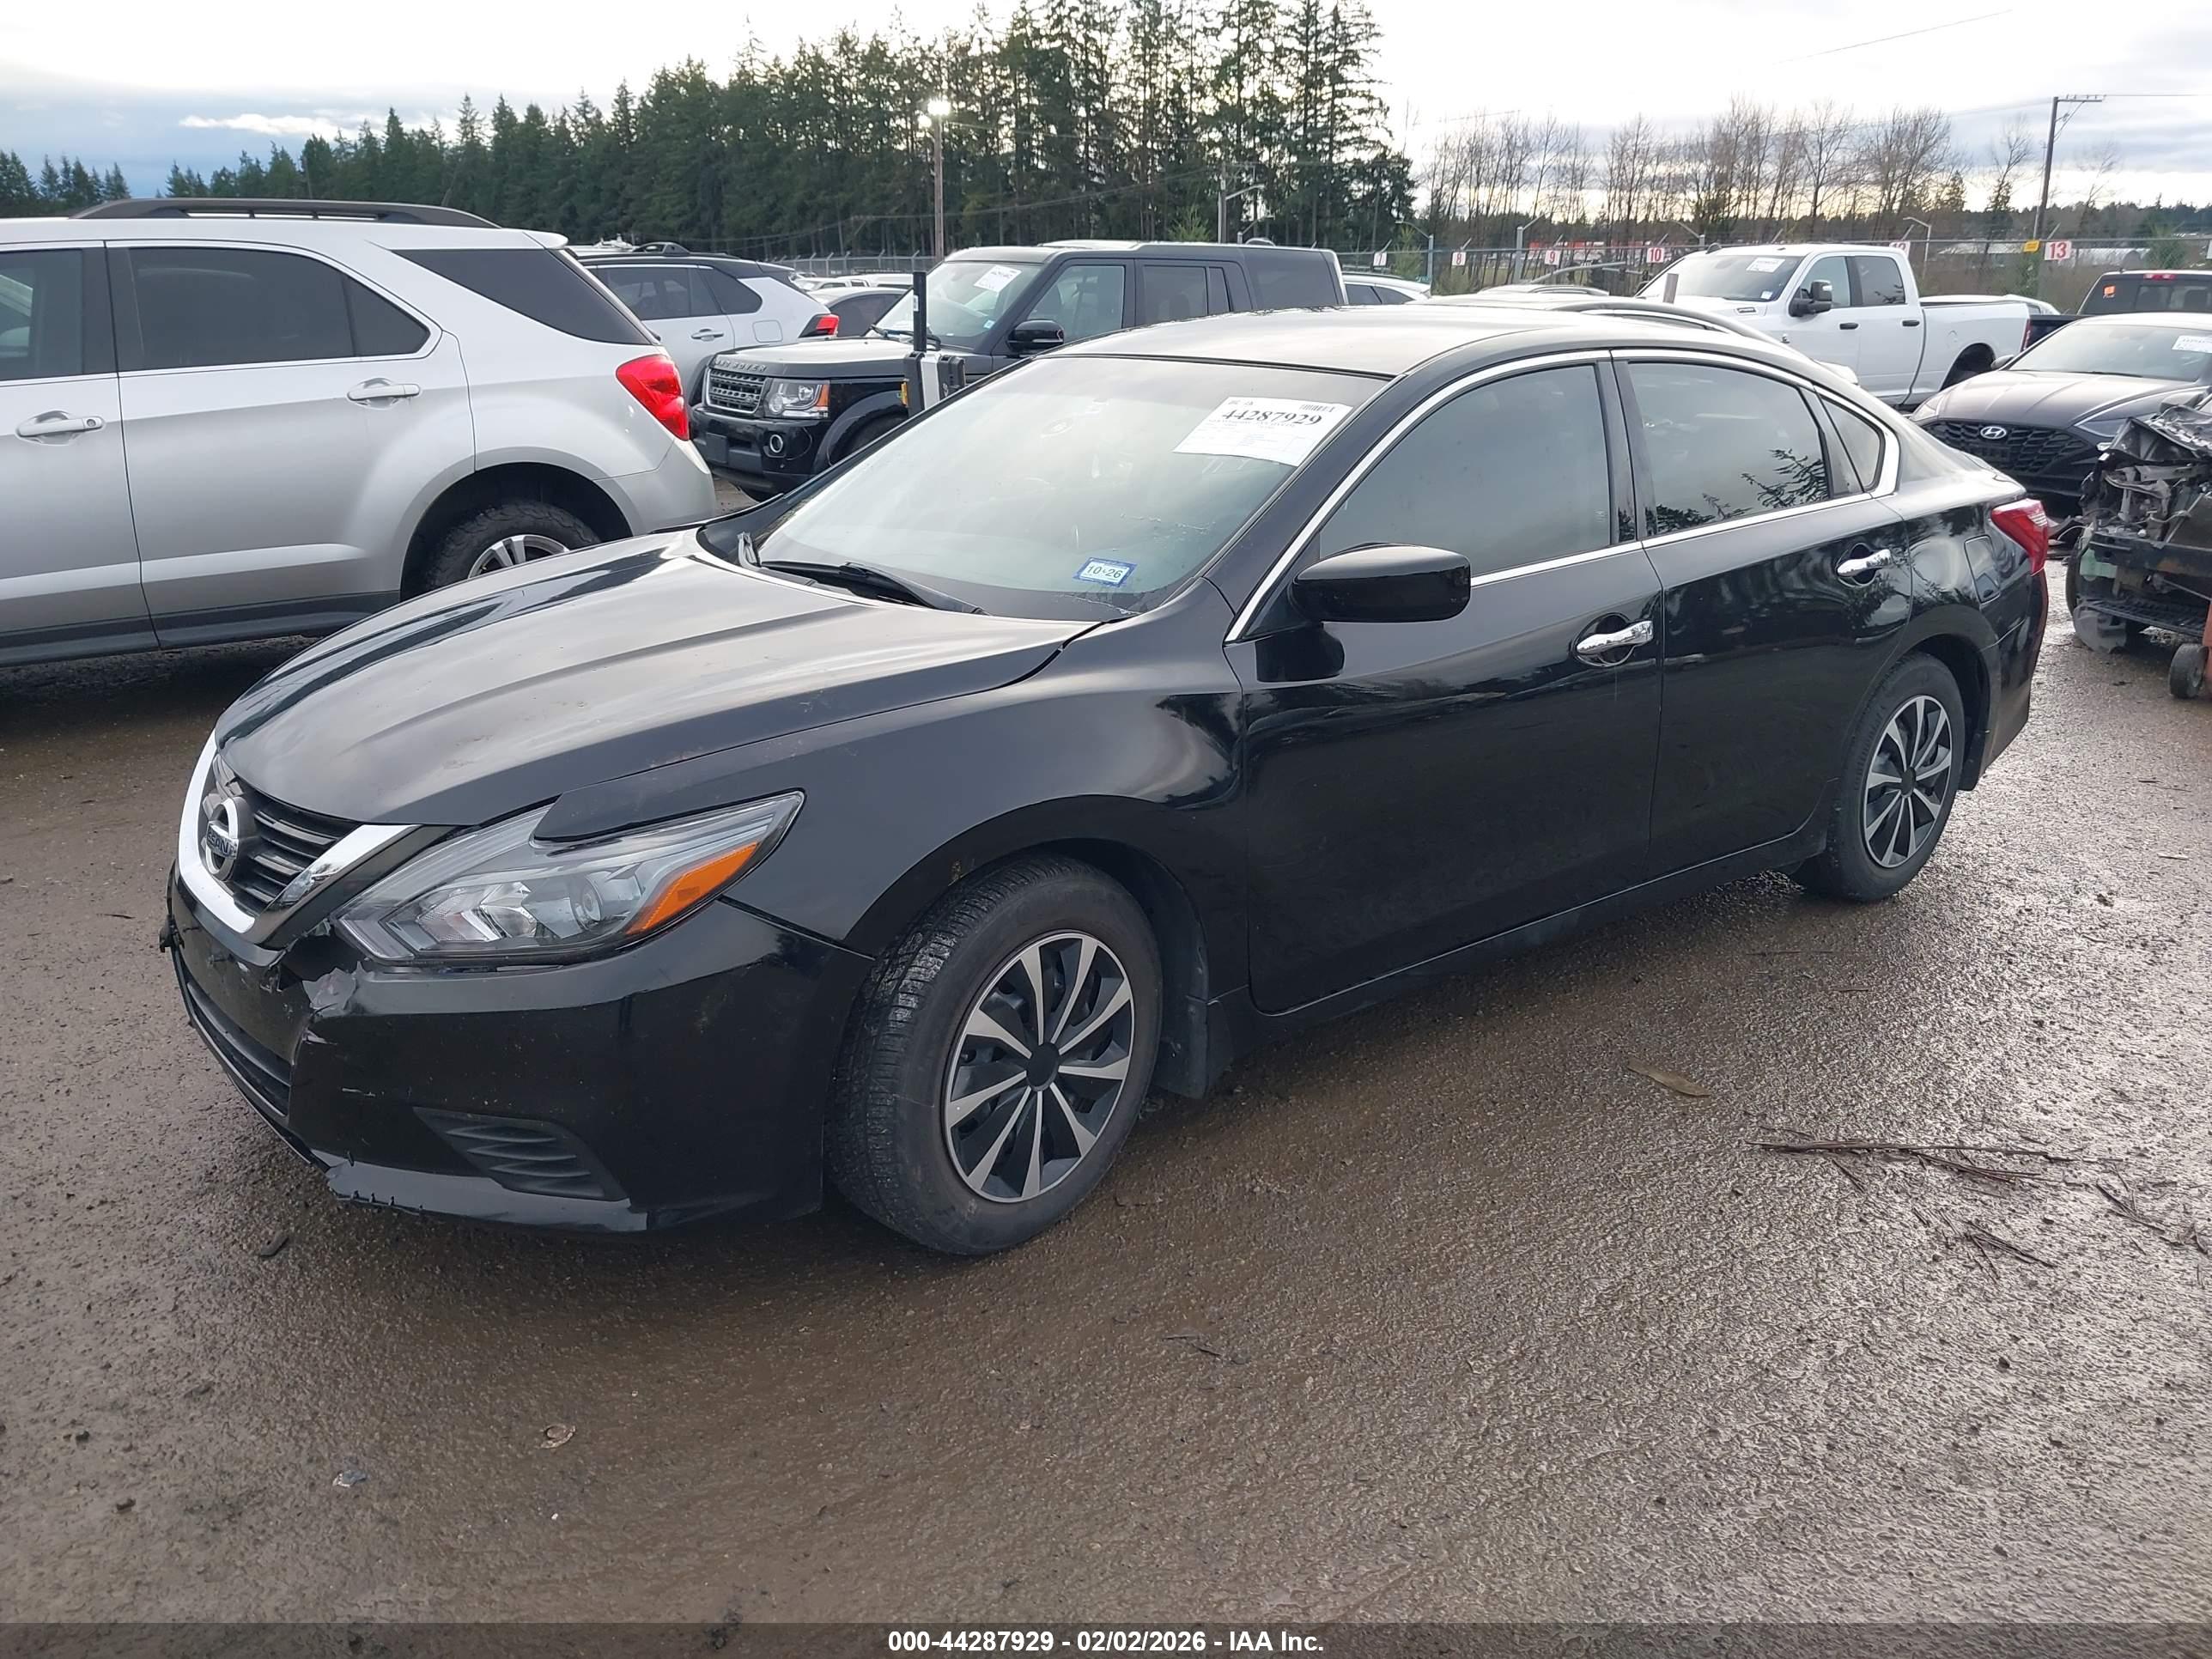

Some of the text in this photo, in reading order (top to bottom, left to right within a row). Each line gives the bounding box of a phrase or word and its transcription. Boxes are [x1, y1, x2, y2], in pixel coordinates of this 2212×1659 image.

[1650, 247, 1662, 262] 10
[2049, 241, 2068, 259] 13
[1455, 252, 1462, 265] 8
[1548, 251, 1556, 264] 9
[1222, 409, 1323, 426] 44287929
[1086, 565, 1123, 579] 10 26
